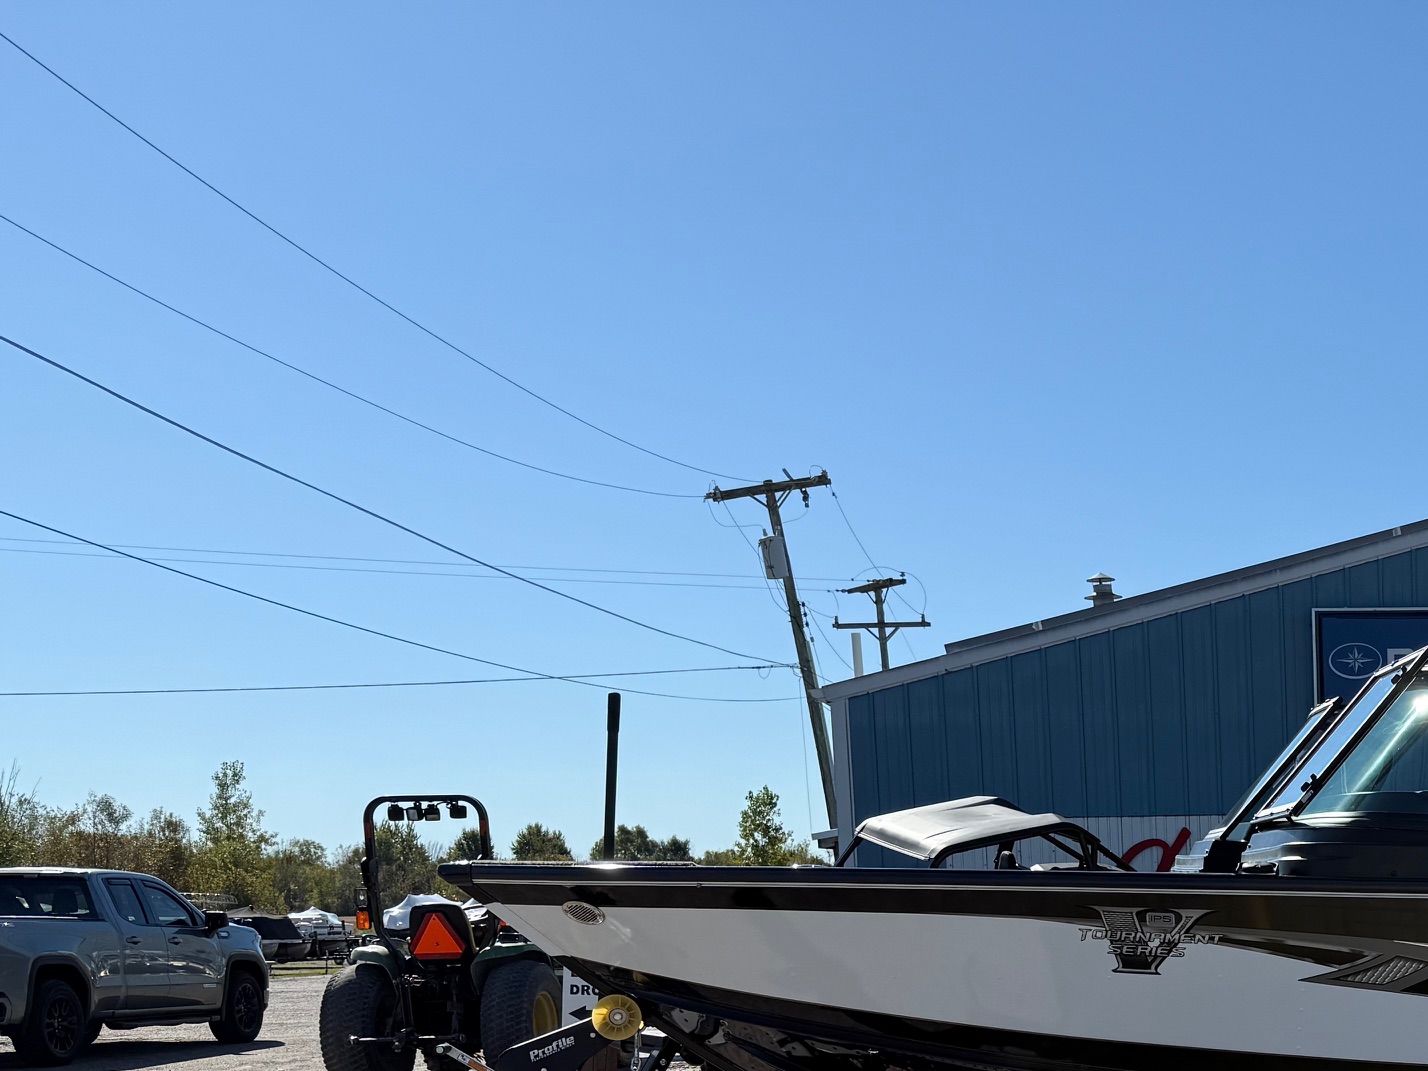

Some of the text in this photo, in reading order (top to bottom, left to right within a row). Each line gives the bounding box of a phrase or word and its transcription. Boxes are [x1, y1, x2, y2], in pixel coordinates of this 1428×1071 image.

[1150, 914, 1172, 923] IPS
[1078, 928, 1224, 945] TOURNAMENT
[1107, 944, 1187, 957] SERIES
[529, 1036, 575, 1061] Profile
